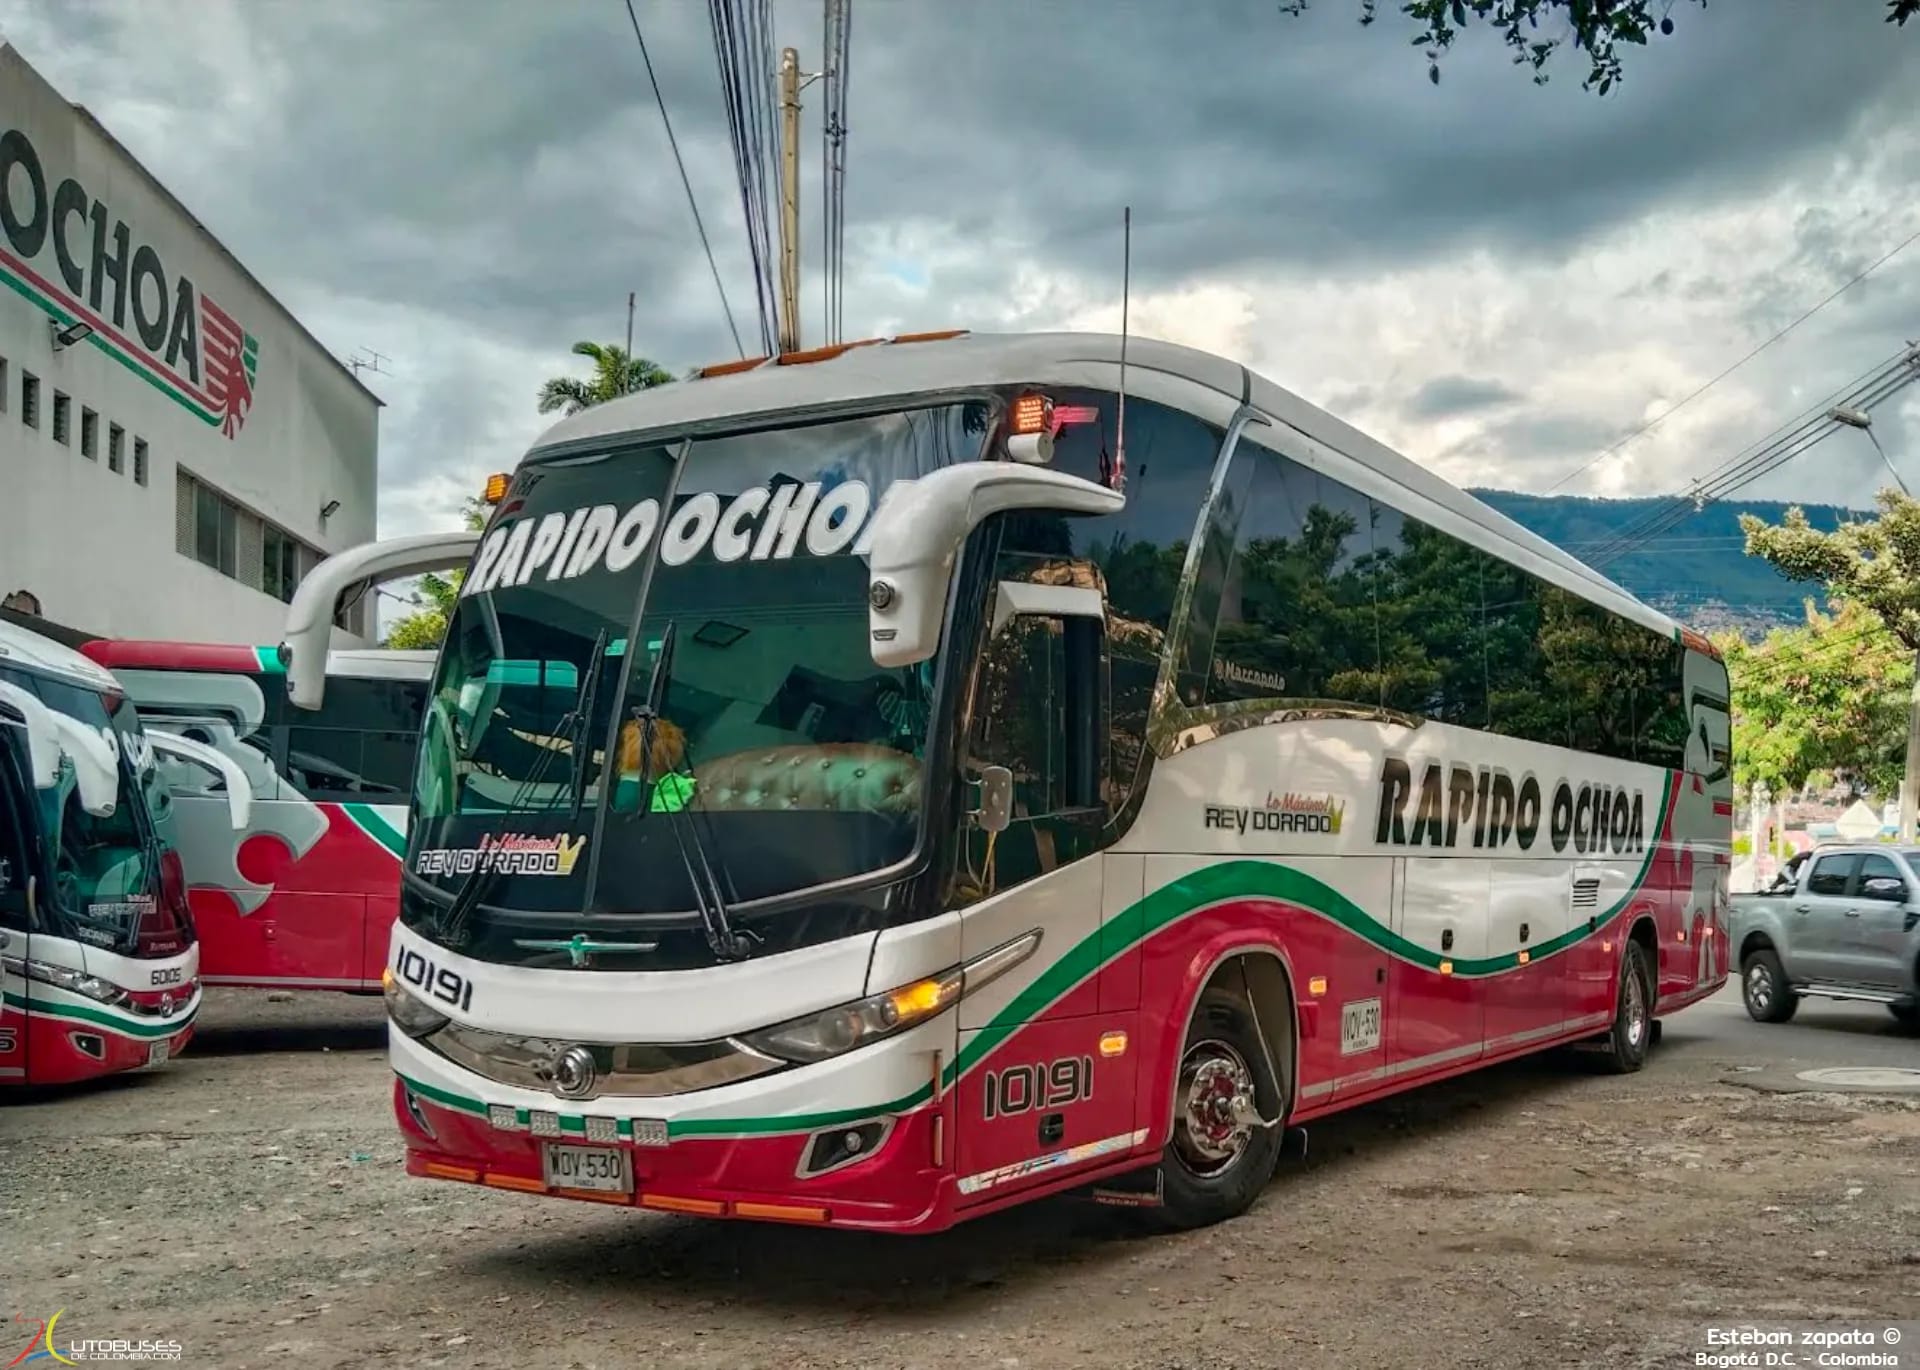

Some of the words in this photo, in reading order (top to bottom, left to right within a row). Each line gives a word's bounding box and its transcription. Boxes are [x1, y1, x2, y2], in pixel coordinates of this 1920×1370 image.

[0, 129, 200, 385] OCHOA
[461, 498, 660, 598] RAPIDO
[1205, 808, 1249, 835] REY
[1252, 811, 1332, 833] DORADO
[1376, 757, 1541, 850] RAPIDO
[1551, 778, 1643, 855] OCHOA
[416, 849, 458, 877] REY
[151, 966, 182, 985] 60105
[396, 943, 473, 1012] 10191
[984, 1055, 1094, 1120] 10191
